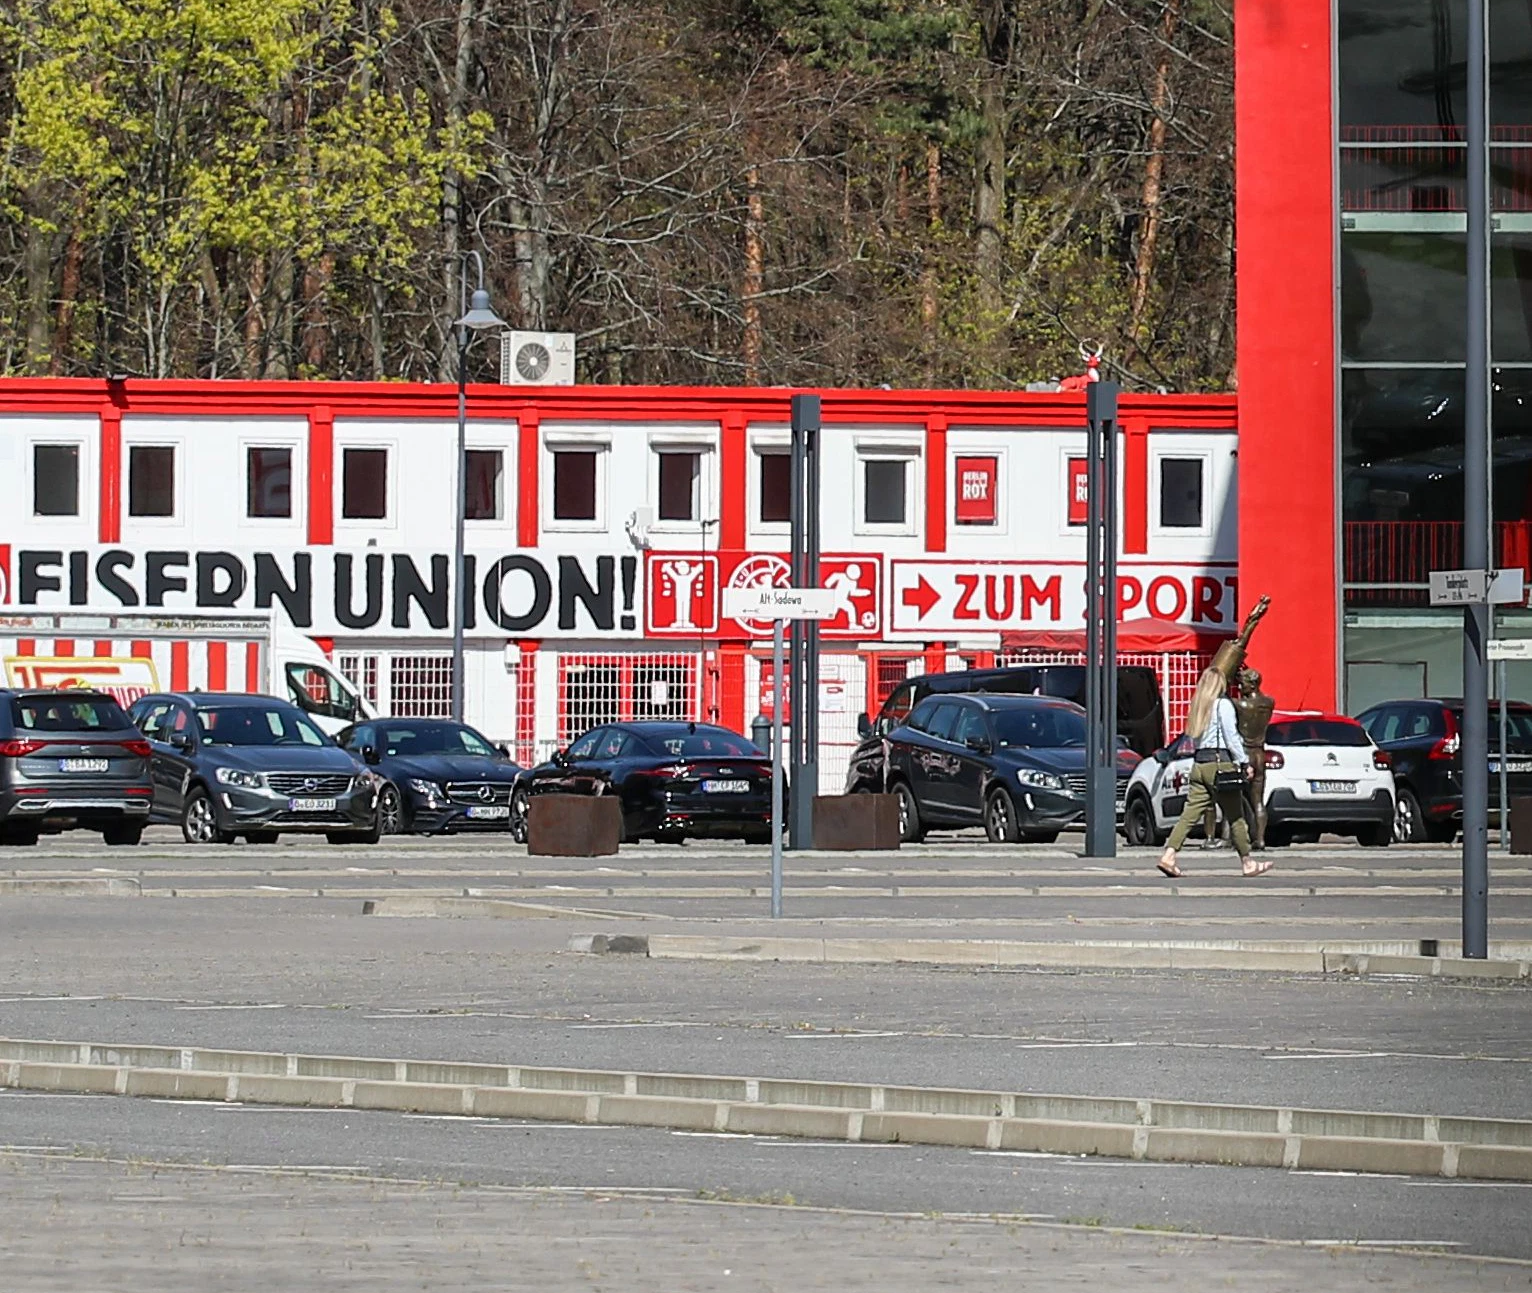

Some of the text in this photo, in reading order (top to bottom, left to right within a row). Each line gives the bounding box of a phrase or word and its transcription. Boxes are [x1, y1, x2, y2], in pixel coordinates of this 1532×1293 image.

[962, 484, 988, 500] ROT
[963, 471, 988, 481] BERLIN
[334, 553, 637, 630] UNION!
[953, 574, 1062, 622] ZUM
